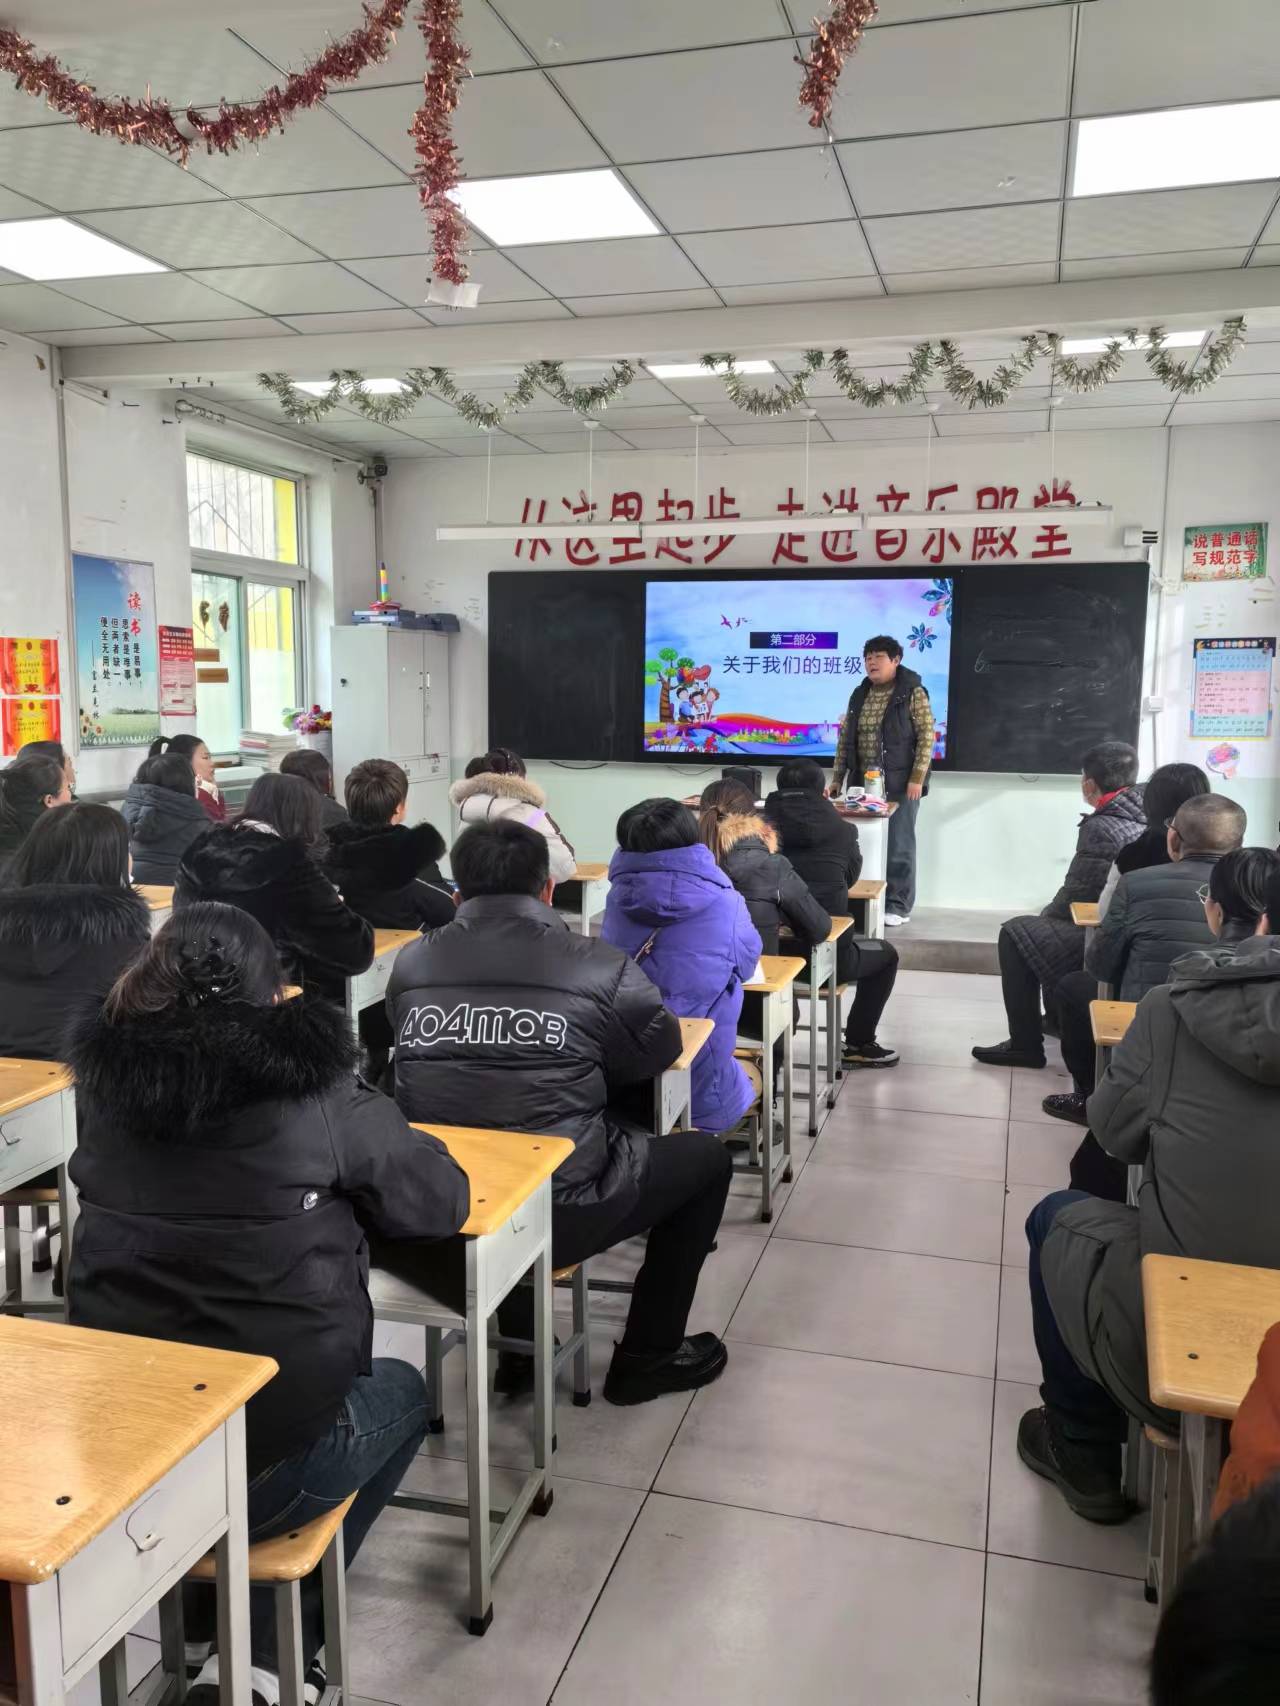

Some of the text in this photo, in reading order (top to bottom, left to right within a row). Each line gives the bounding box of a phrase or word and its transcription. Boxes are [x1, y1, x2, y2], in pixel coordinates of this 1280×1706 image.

[515, 477, 1077, 566] 从这里起步 走进音乐殿堂
[1193, 530, 1259, 549] 说普通话
[1192, 549, 1258, 567] 写规范字
[770, 633, 817, 647] 第二部分
[722, 655, 863, 675] 关于我们的班级
